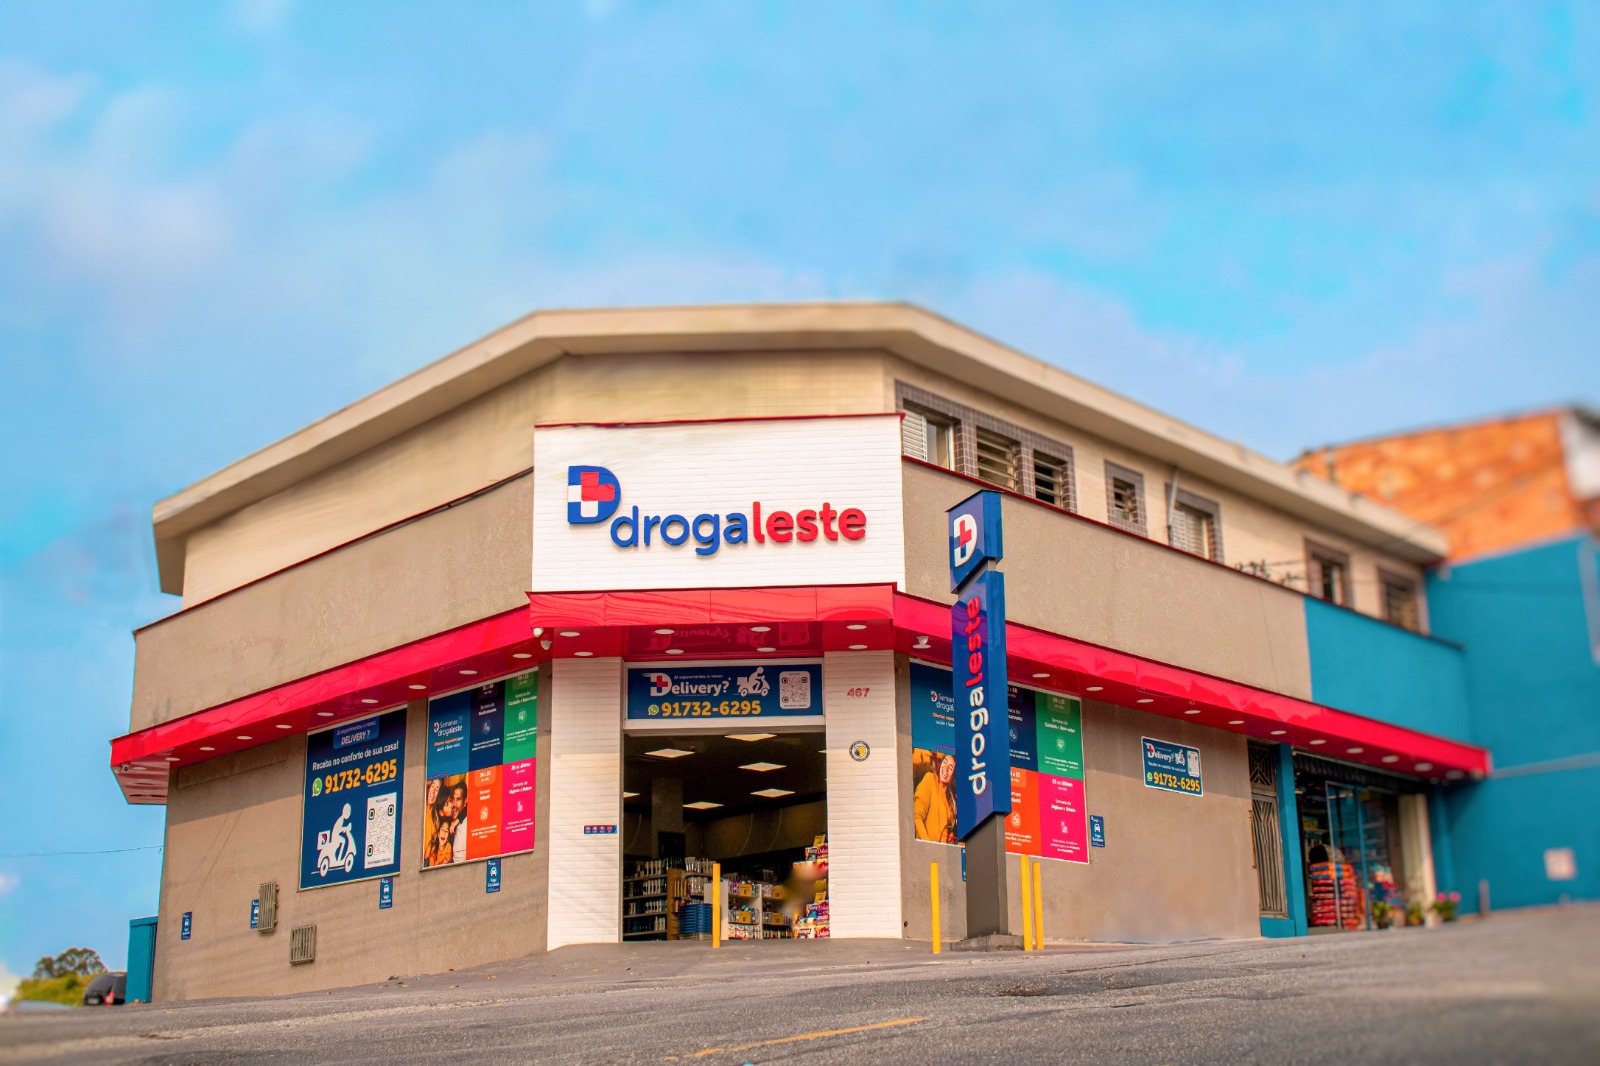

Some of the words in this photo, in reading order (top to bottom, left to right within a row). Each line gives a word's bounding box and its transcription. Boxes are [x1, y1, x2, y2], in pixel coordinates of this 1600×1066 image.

[610, 501, 867, 556] drogaleste
[847, 688, 870, 697] 467
[964, 596, 989, 796] drogaleste
[662, 700, 762, 717] 91732-6295
[341, 730, 367, 745] DELIVERY
[333, 758, 340, 766] no
[372, 746, 383, 756] sua
[325, 759, 397, 794] 91732-6295
[1154, 772, 1200, 792] 91732-6295
